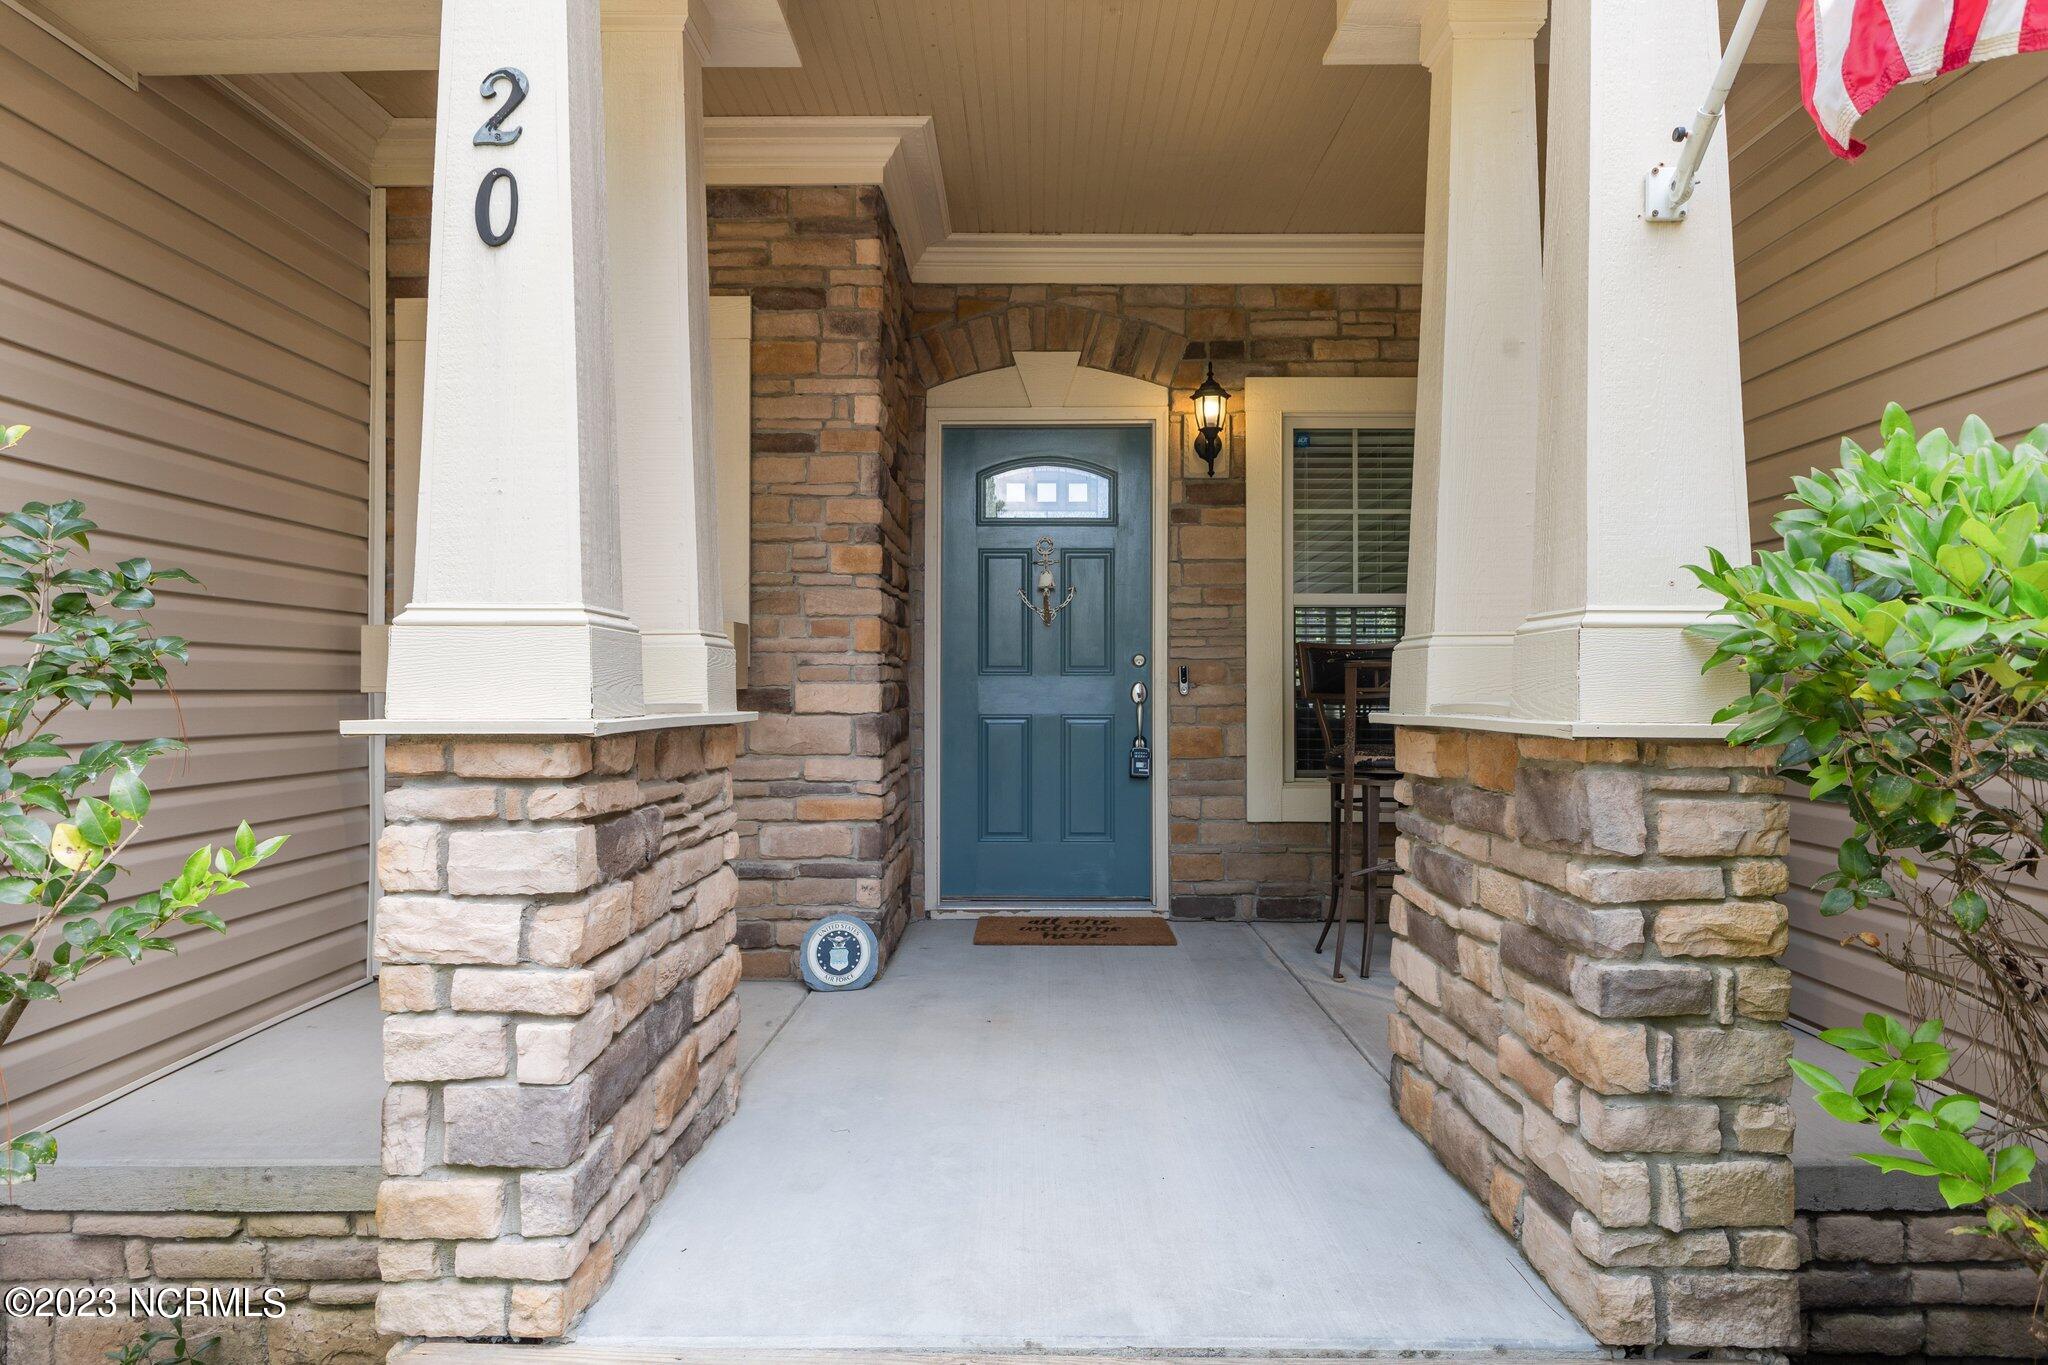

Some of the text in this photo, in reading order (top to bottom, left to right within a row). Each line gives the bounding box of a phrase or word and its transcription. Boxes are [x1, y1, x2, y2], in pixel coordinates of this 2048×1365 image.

[1028, 917, 1060, 925] all
[818, 923, 860, 937] UNITED STATES
[1019, 923, 1128, 932] welcome
[1042, 931, 1107, 940] here
[825, 974, 854, 983] AIR FORCE
